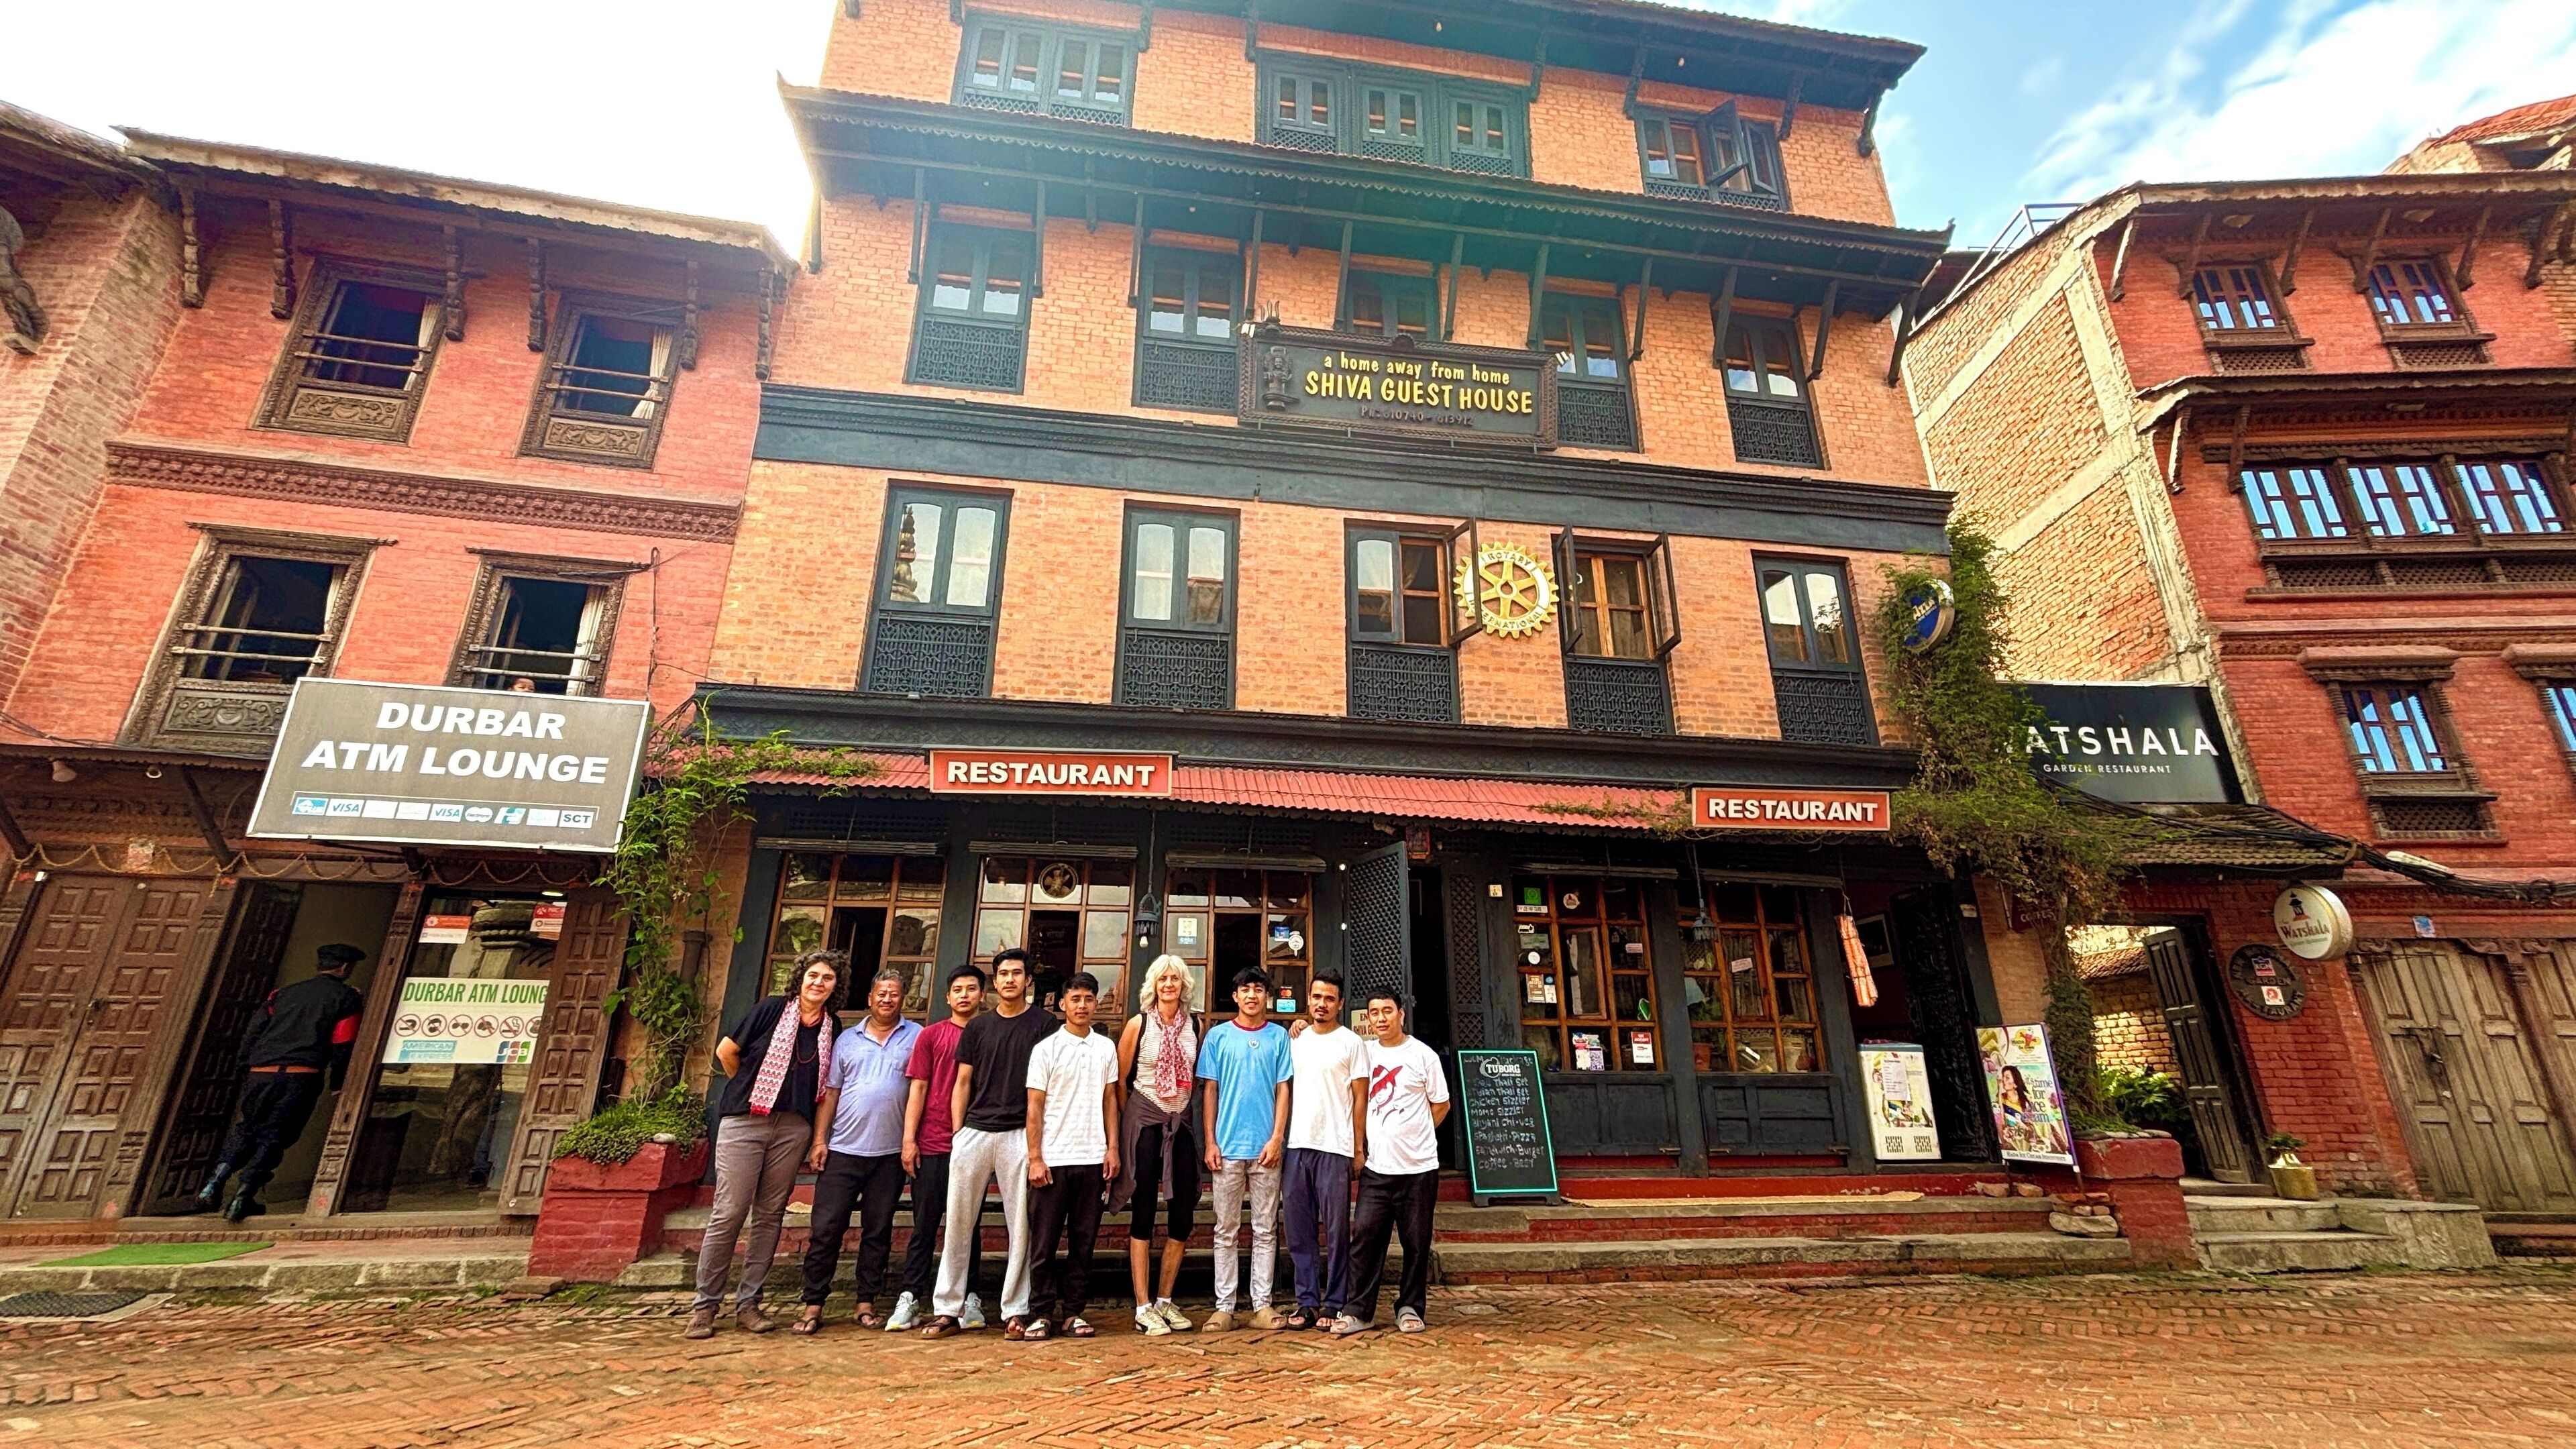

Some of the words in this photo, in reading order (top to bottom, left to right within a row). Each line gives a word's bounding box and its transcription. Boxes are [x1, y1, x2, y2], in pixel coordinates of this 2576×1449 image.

[1324, 355, 1332, 368] a
[1340, 352, 1379, 373] home
[1387, 360, 1421, 378] away
[1431, 360, 1464, 380] from
[1472, 364, 1509, 385] home
[1305, 370, 1372, 400] SHIVA
[1381, 378, 1453, 408] GUEST
[1459, 387, 1533, 414] HOUSE
[1487, 551, 1532, 566] ROTARY
[376, 702, 566, 739] DURBAR
[2006, 726, 2219, 756] ATSHALA
[301, 740, 409, 773] ATM
[419, 748, 610, 784] LOUNGE
[2043, 763, 2092, 773] GARDEN
[2098, 764, 2171, 773] RESTAURANT
[947, 761, 1155, 787] RESTAURANT
[332, 804, 360, 813] VISA
[434, 807, 460, 818] VISA
[562, 814, 591, 824] SCT
[1709, 798, 1878, 822] RESTAURANT
[402, 982, 466, 1002] DURBAR
[468, 983, 500, 1003] ATM
[402, 1041, 453, 1051] AMERICAN
[497, 1048, 529, 1057] JCB
[411, 1052, 453, 1060] EXPRESS
[1486, 1064, 1521, 1073] TUBORG
